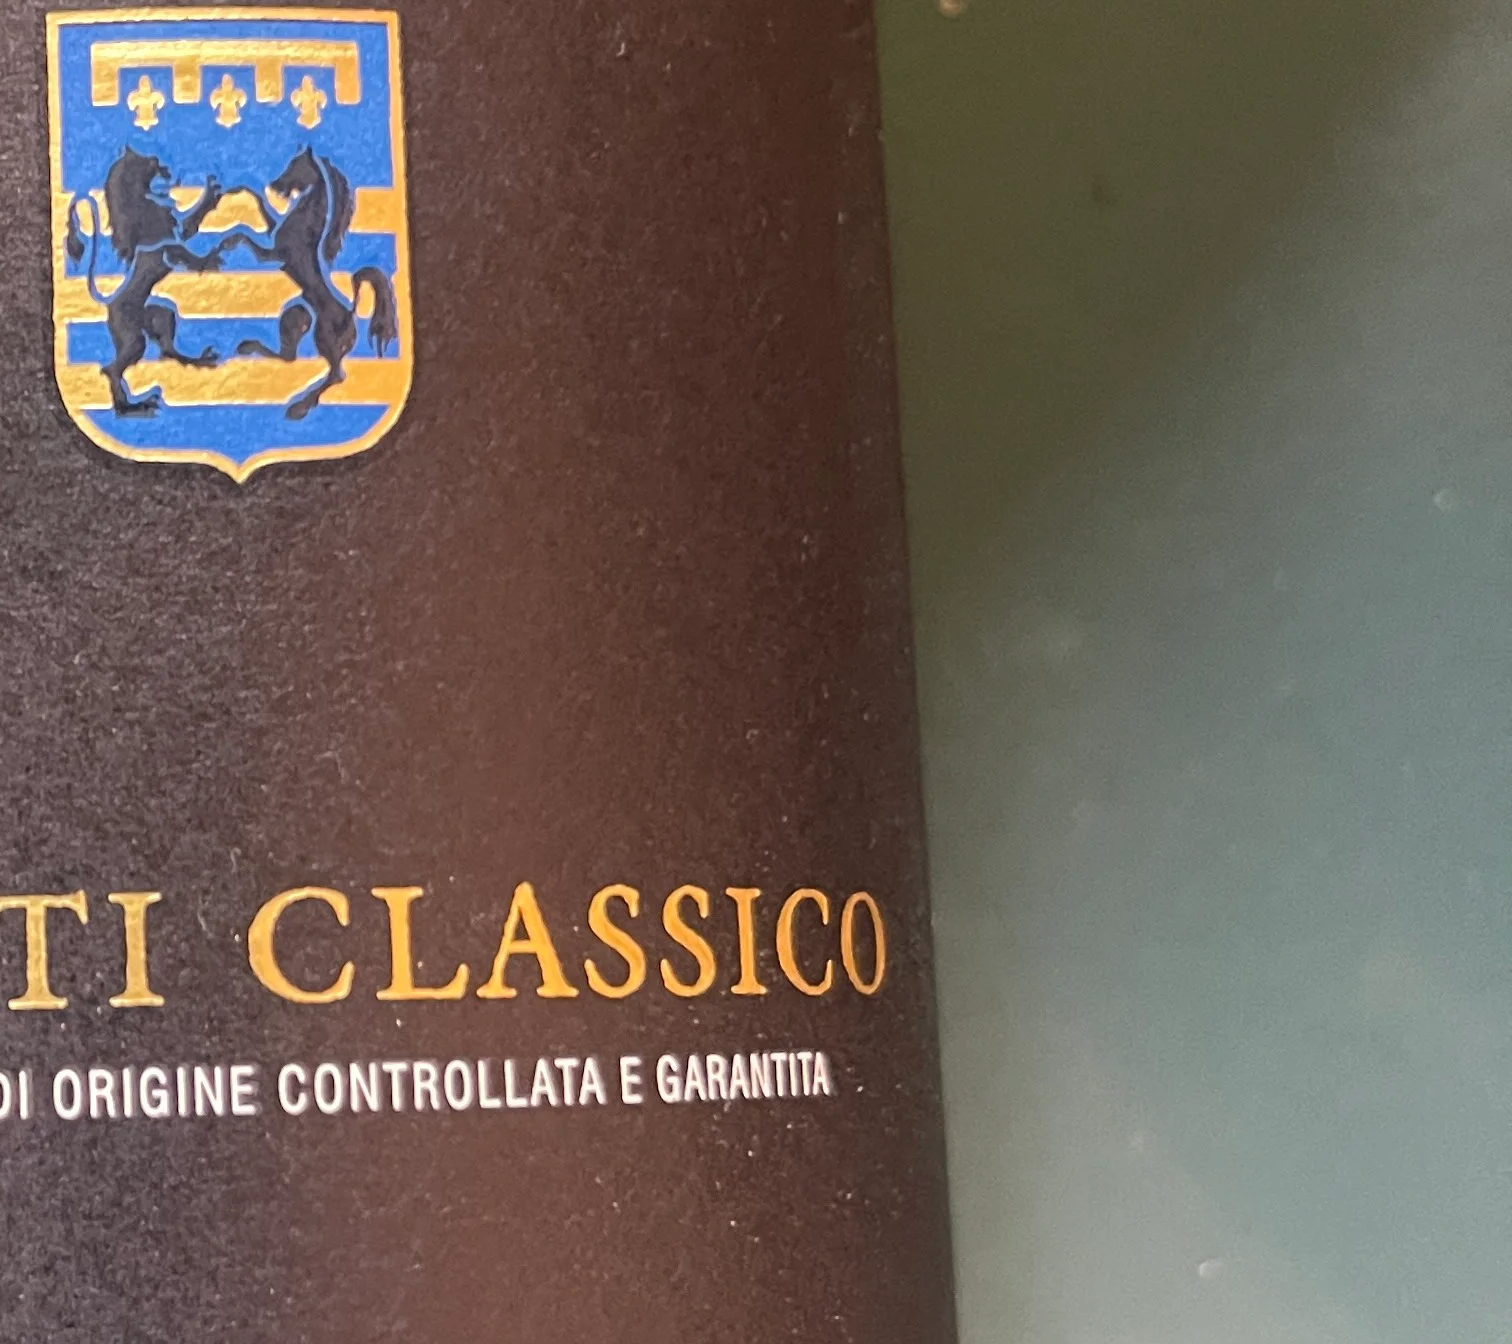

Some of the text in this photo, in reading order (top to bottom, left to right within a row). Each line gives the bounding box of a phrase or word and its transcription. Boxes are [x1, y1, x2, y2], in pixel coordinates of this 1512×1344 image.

[247, 881, 886, 1004] CLASSICO
[52, 1063, 257, 1119] ORIGINE
[278, 1057, 605, 1116] CONTROLLATA
[620, 1056, 643, 1104] E
[657, 1051, 831, 1102] GARANTITA
